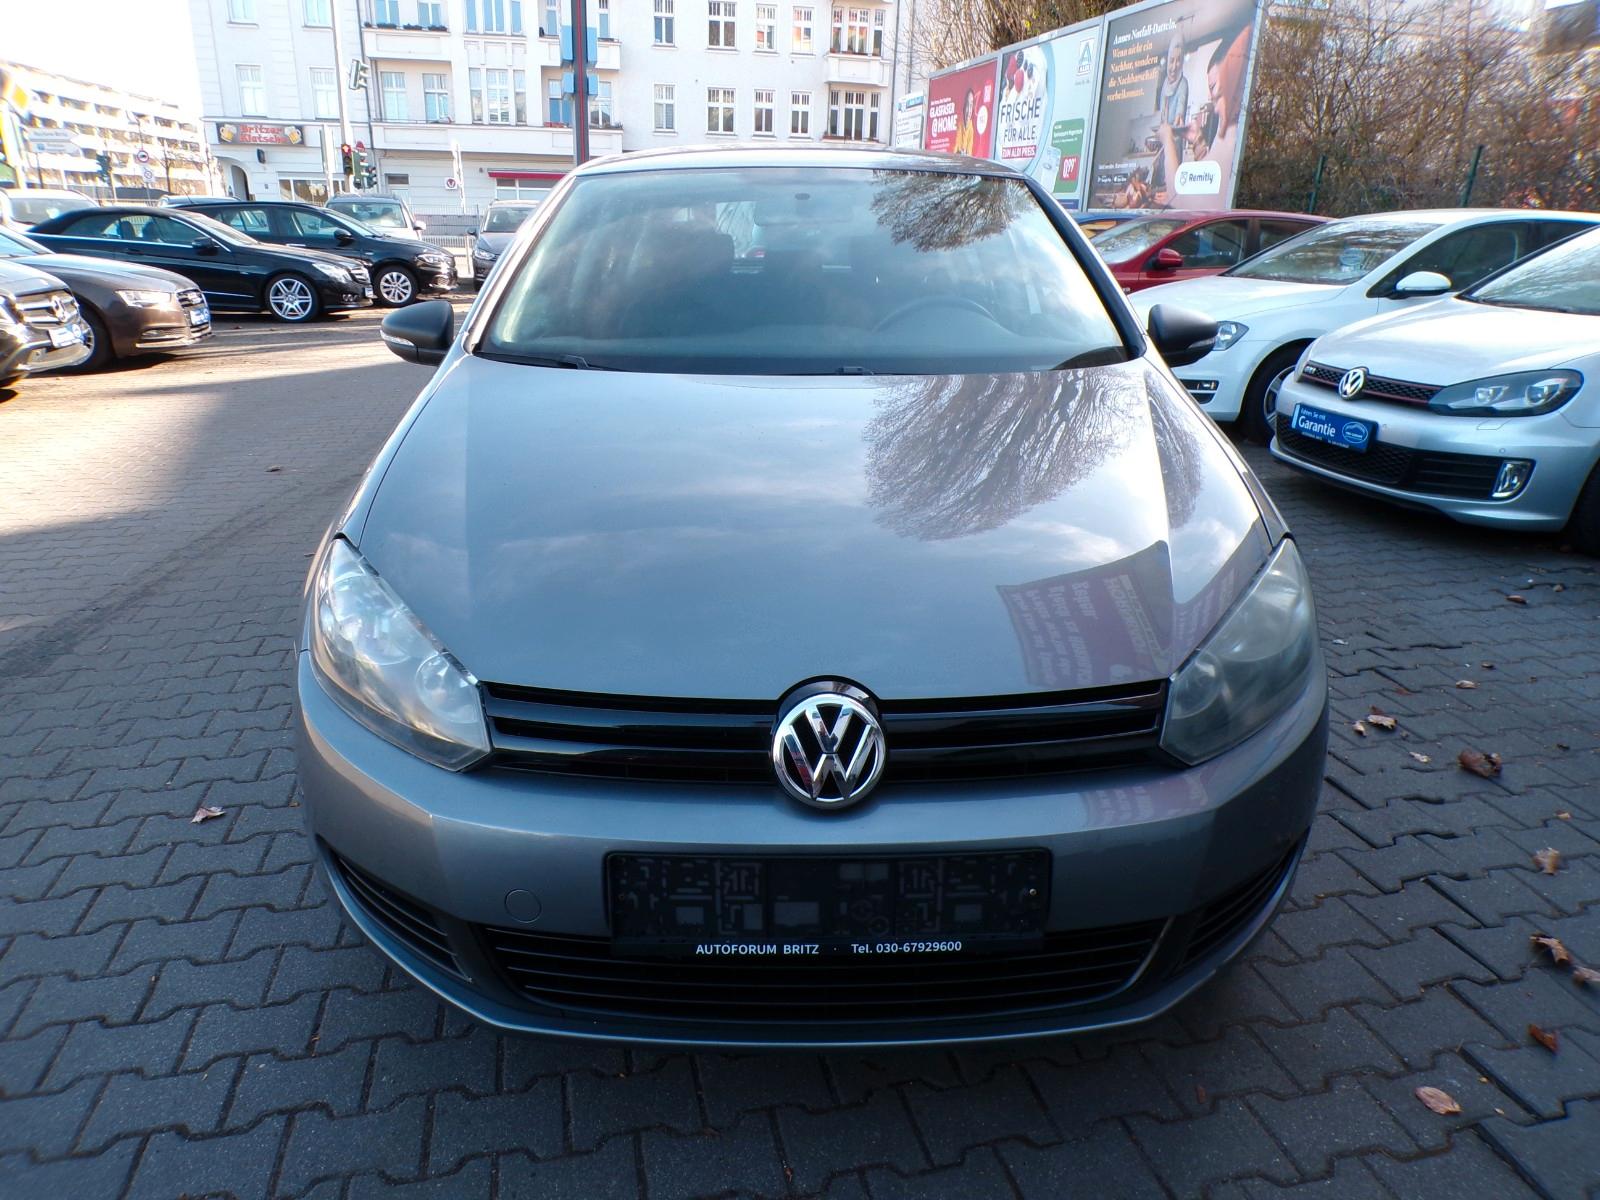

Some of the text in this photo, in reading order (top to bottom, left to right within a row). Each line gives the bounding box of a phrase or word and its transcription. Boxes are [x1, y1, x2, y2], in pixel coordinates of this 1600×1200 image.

[1001, 97, 1041, 123] FRISCHE
[932, 114, 957, 137] @HOME
[1003, 125, 1017, 142] FÜR
[1188, 170, 1214, 184] Remitly
[1298, 416, 1336, 437] Garantie
[695, 941, 962, 955] AUTOFORUM BRITZ Tel. 030-67929600
